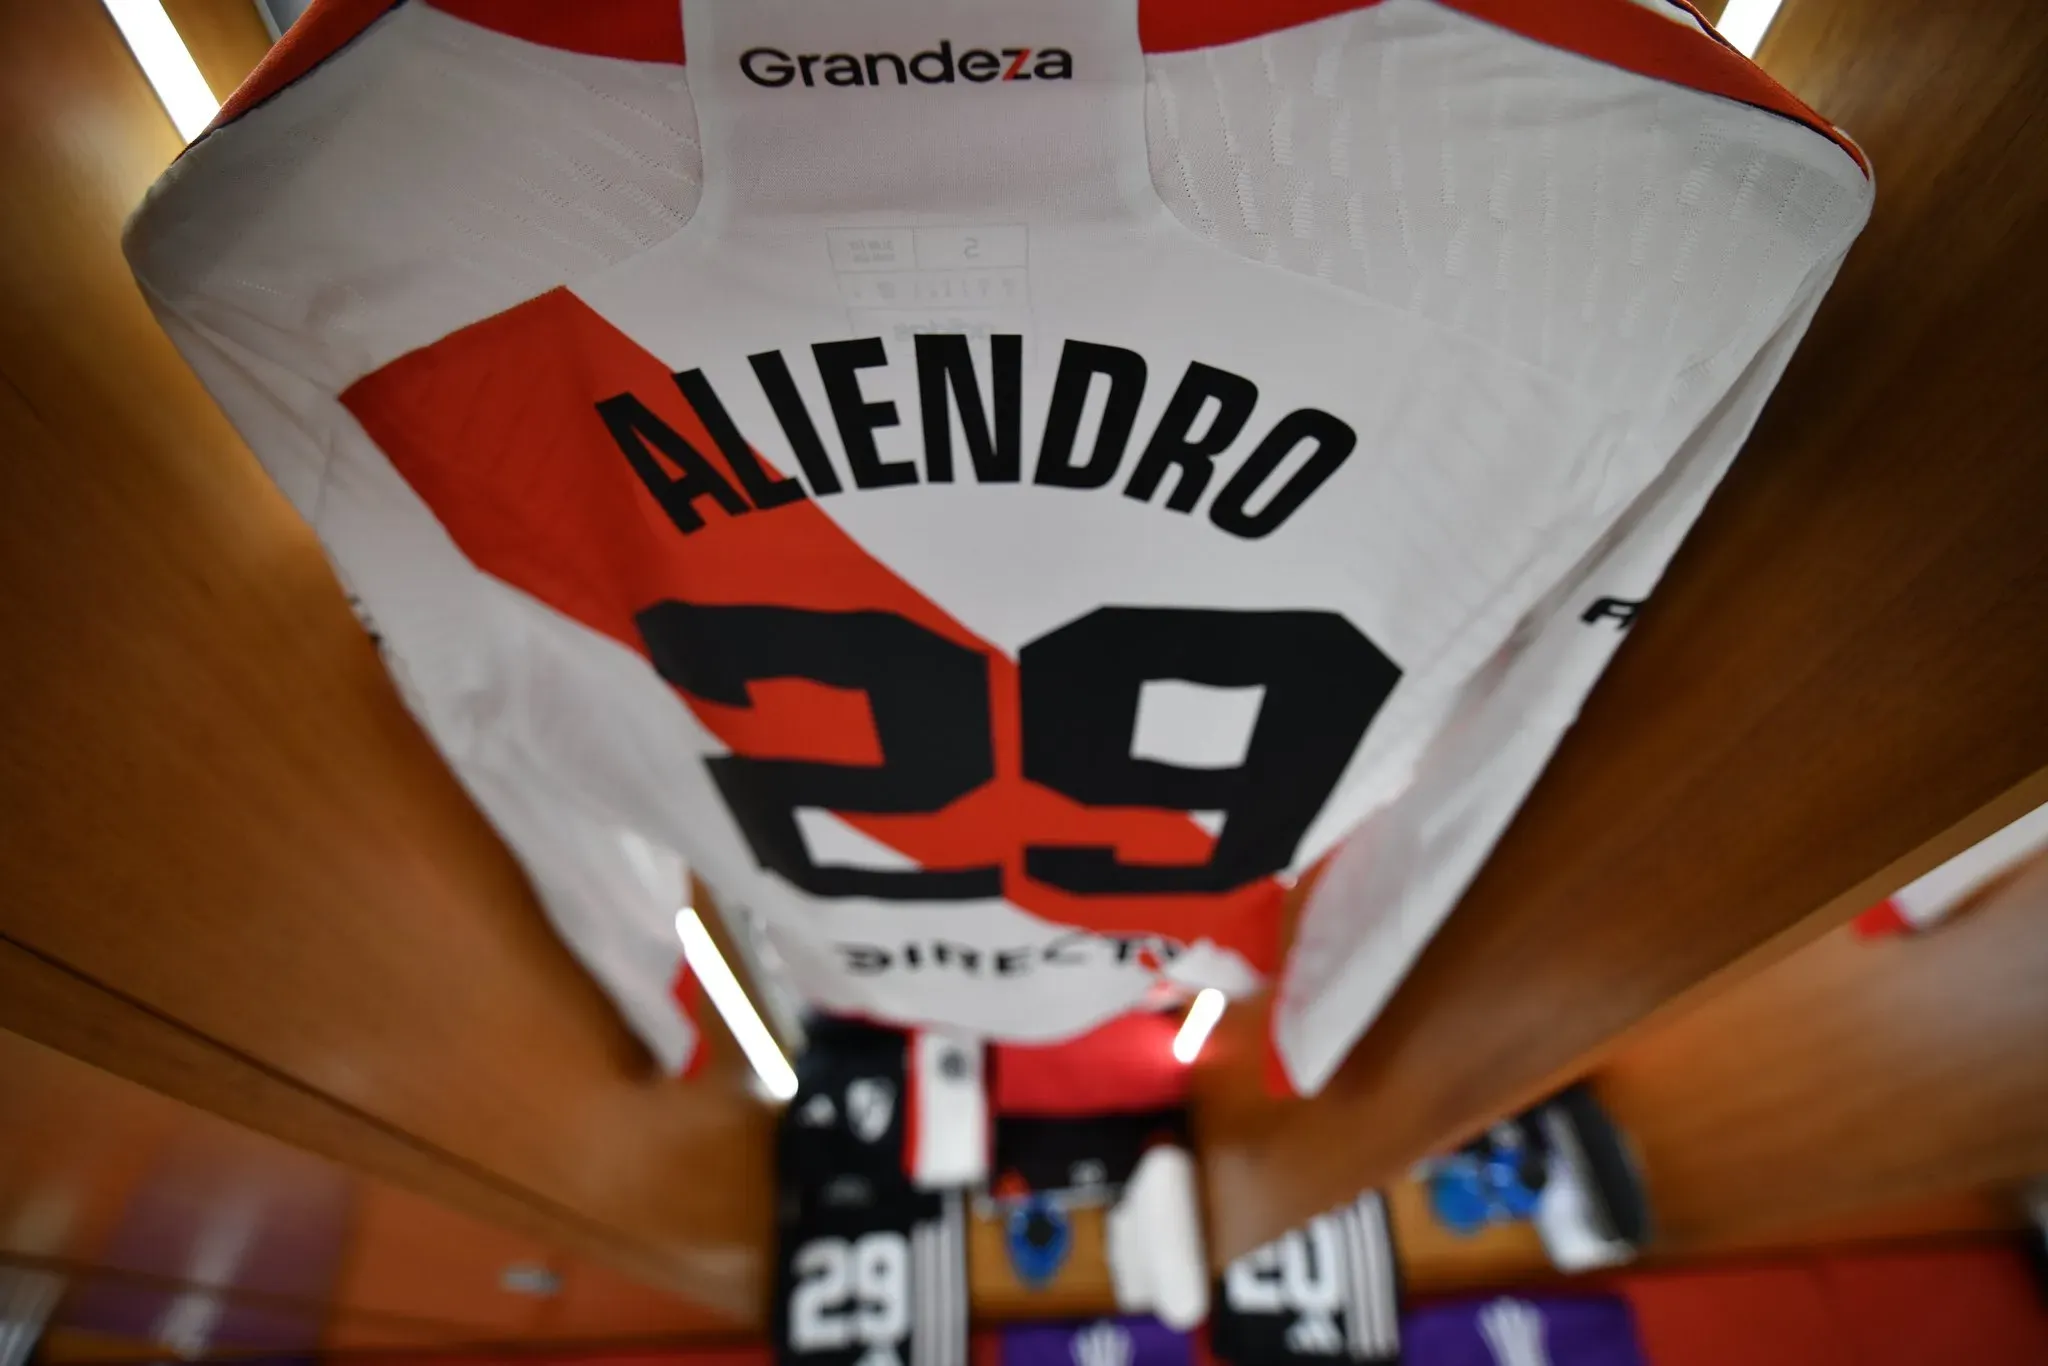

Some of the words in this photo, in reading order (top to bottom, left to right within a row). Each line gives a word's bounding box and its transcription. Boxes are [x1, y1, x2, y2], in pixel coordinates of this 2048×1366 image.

[738, 39, 1073, 89] Grandeza
[594, 334, 1358, 540] ALIENDRO
[630, 598, 1404, 902] 29
[788, 1230, 910, 1354] 29
